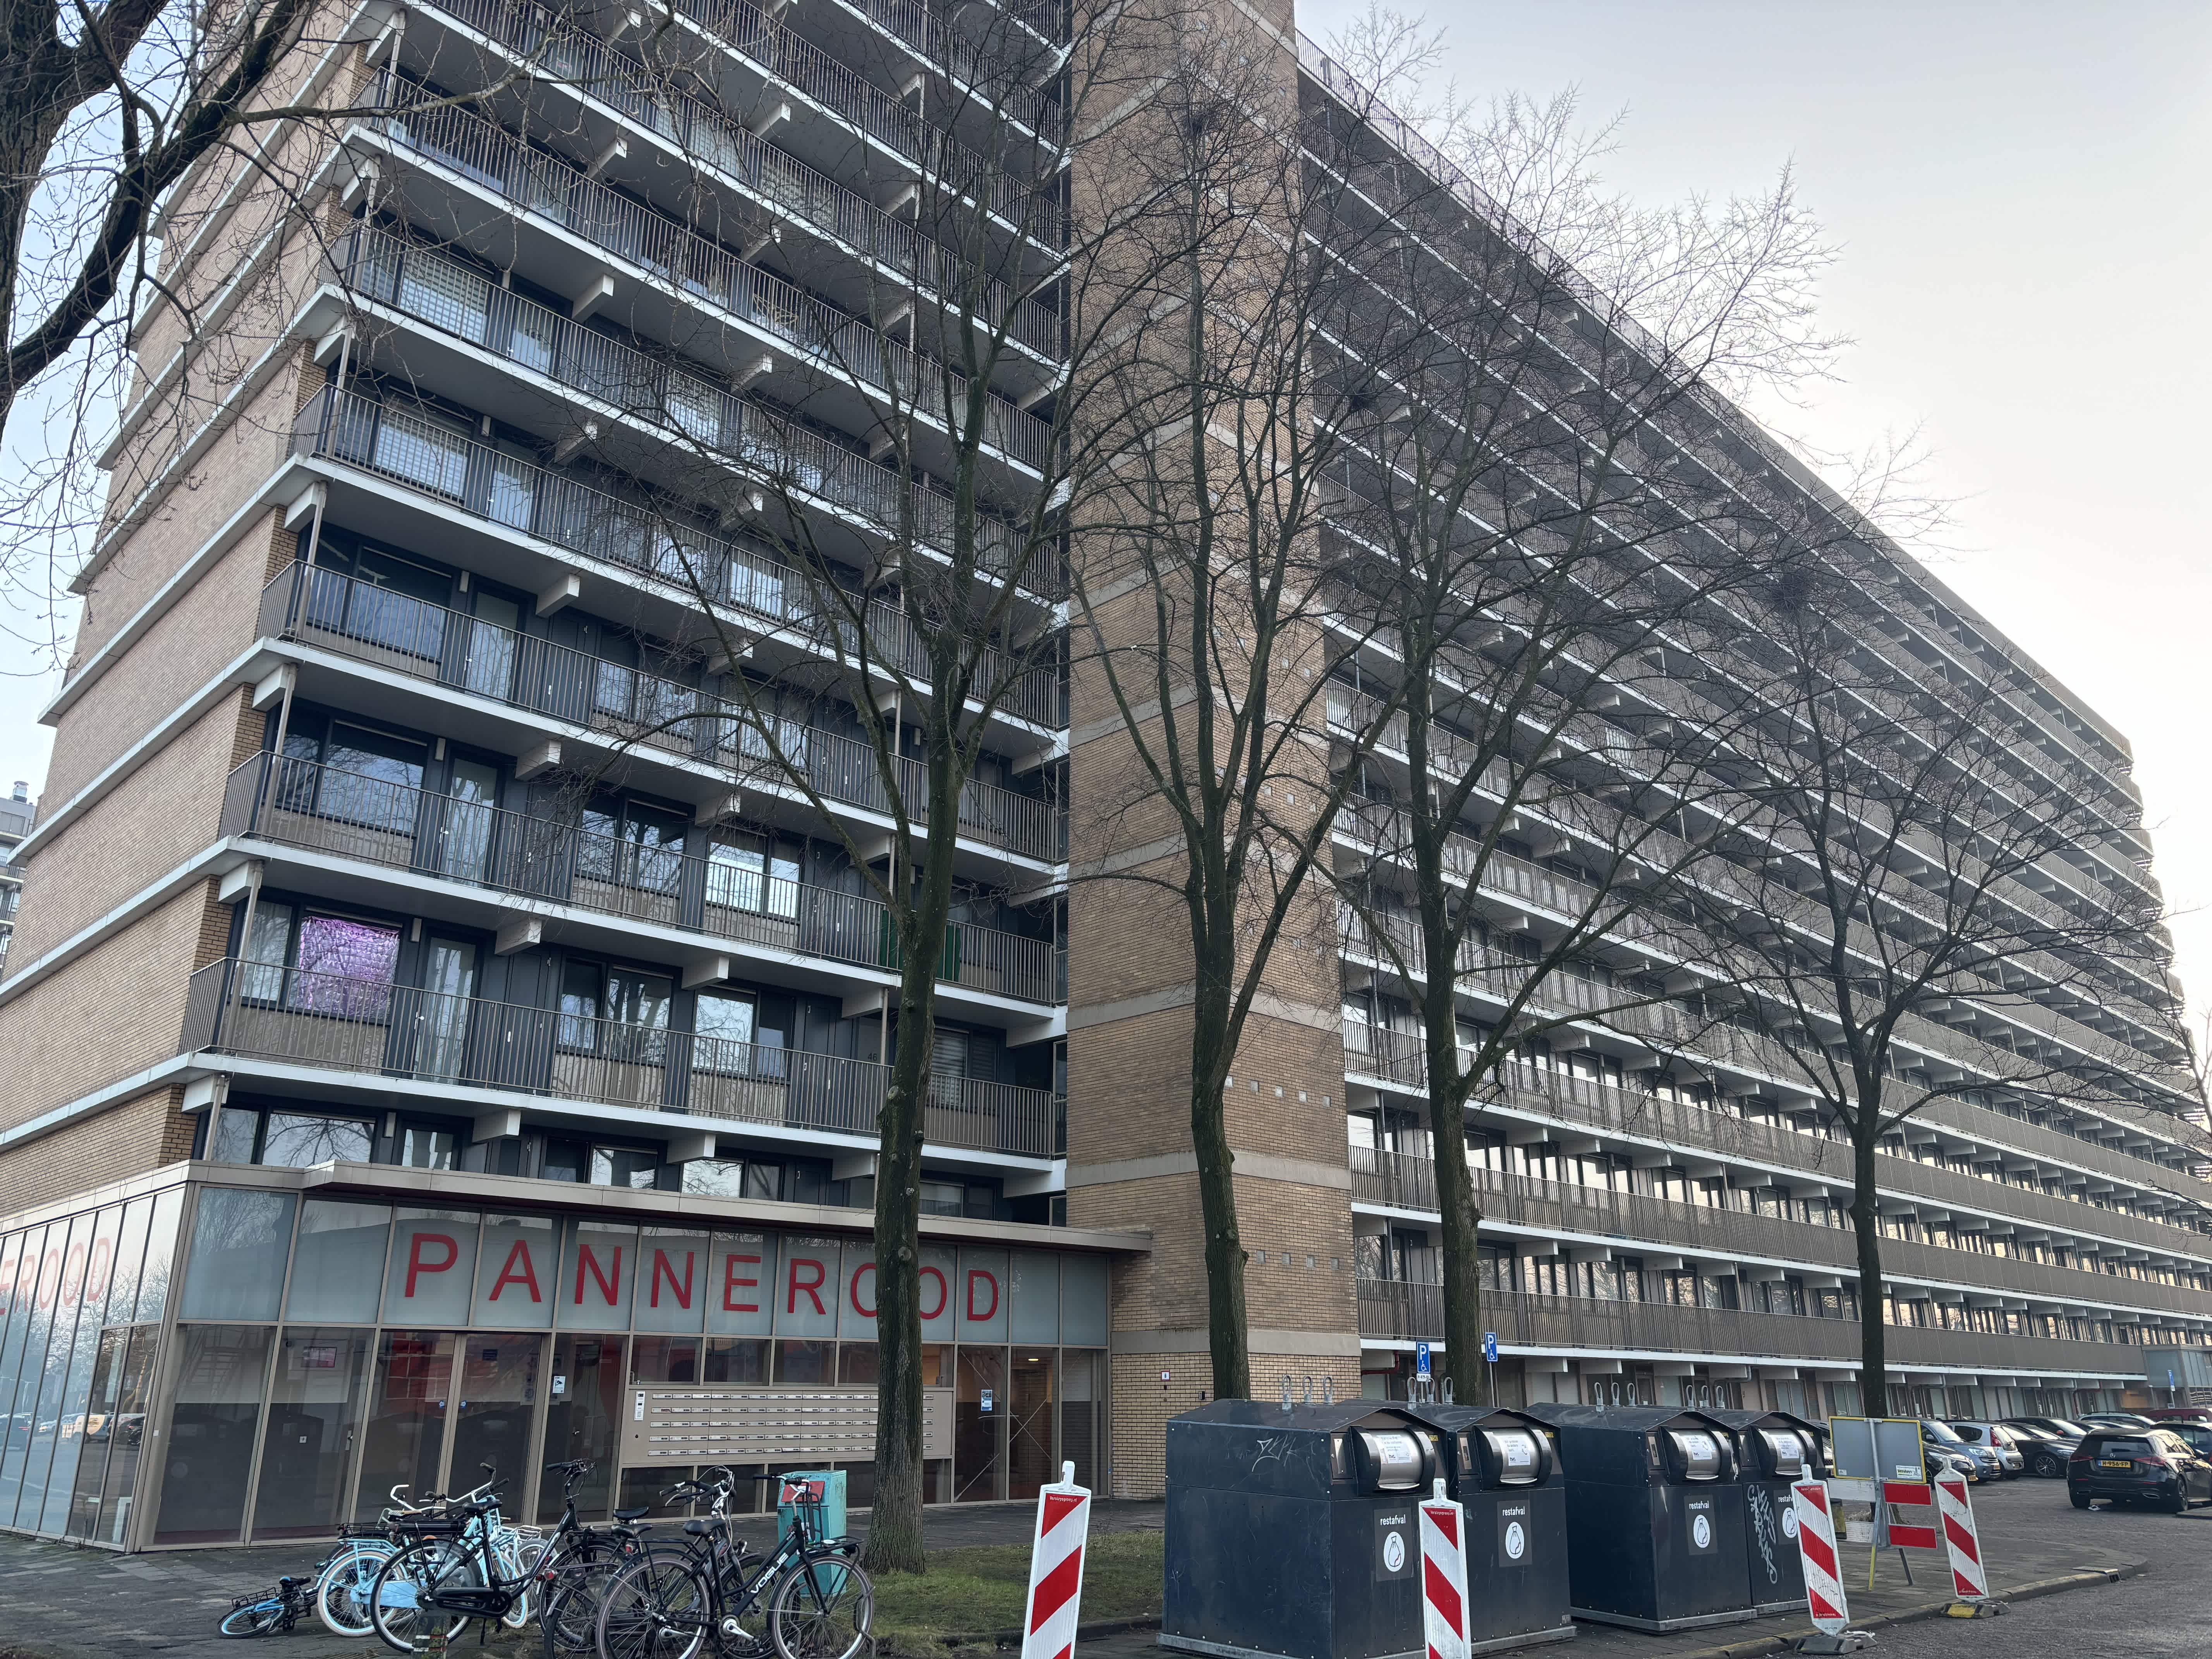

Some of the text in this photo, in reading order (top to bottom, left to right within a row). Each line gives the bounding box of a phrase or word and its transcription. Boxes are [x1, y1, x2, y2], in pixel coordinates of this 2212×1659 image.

[404, 1233, 998, 1321] PANNEROOD
[1488, 1335, 1494, 1349] P
[1420, 1345, 1427, 1360] P
[1503, 1506, 1525, 1516] restafval
[1689, 1500, 1709, 1509] restafval
[1380, 1514, 1406, 1526] restafval
[750, 1552, 789, 1594] VOGUE
